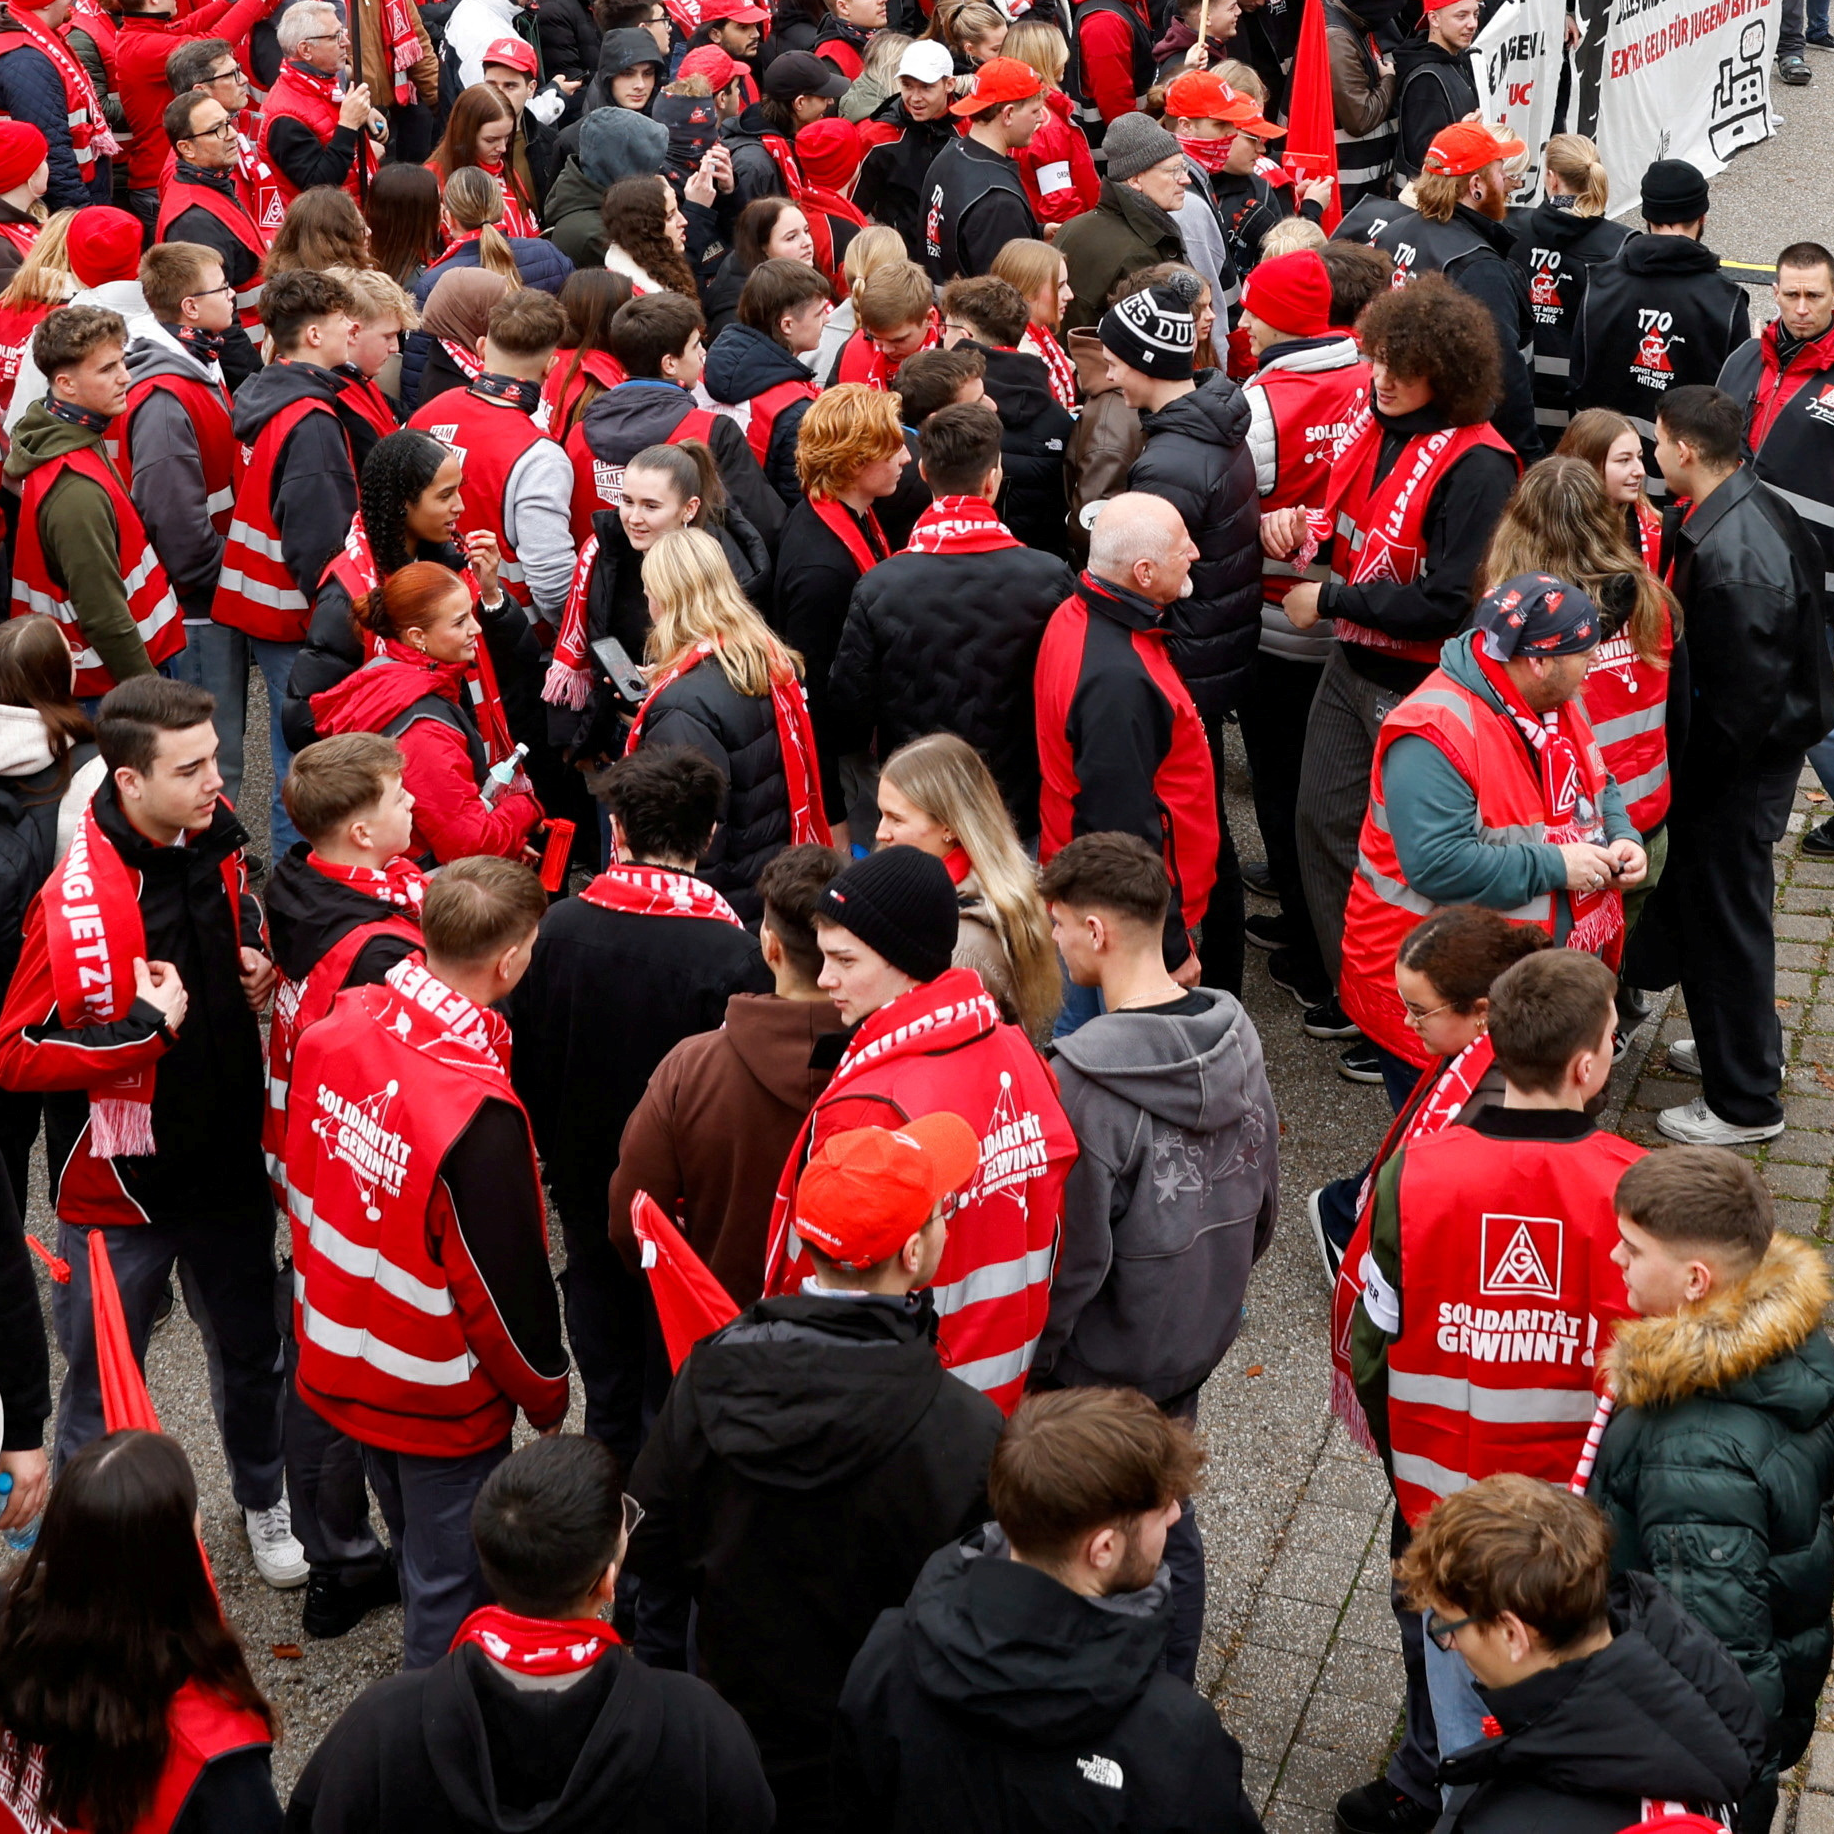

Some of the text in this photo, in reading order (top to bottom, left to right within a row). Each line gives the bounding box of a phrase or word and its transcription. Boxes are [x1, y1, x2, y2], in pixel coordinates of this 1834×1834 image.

[1610, 44, 1644, 79] EXTRA
[1643, 30, 1668, 68] GELD
[1667, 14, 1690, 55] FÜR
[1689, 2, 1730, 49] JUGEND
[1056, 170, 1070, 180] ORD
[1366, 218, 1389, 240] 17
[1393, 241, 1417, 268] 170
[1529, 247, 1562, 270] 170
[1534, 312, 1559, 325] TZIG
[1637, 307, 1674, 333] 170
[1629, 365, 1676, 382] SONST WIRD'S
[1636, 375, 1668, 392] HITZIG
[430, 427, 453, 441] TEAM
[1305, 422, 1348, 443] SOLID
[67, 902, 116, 1018] JETZT!
[316, 1082, 413, 1167] SOLIDARITÄT
[977, 1110, 1044, 1164] LIDARITÄT
[337, 1123, 408, 1188] GEWINNT
[981, 1170, 1028, 1198] TARIFBEWEGUN
[1437, 1301, 1581, 1335] SOLIDARITÄT
[1076, 1757, 1110, 1774] NORTH
[1092, 1753, 1111, 1766] THE
[1082, 1767, 1109, 1784] FACE
